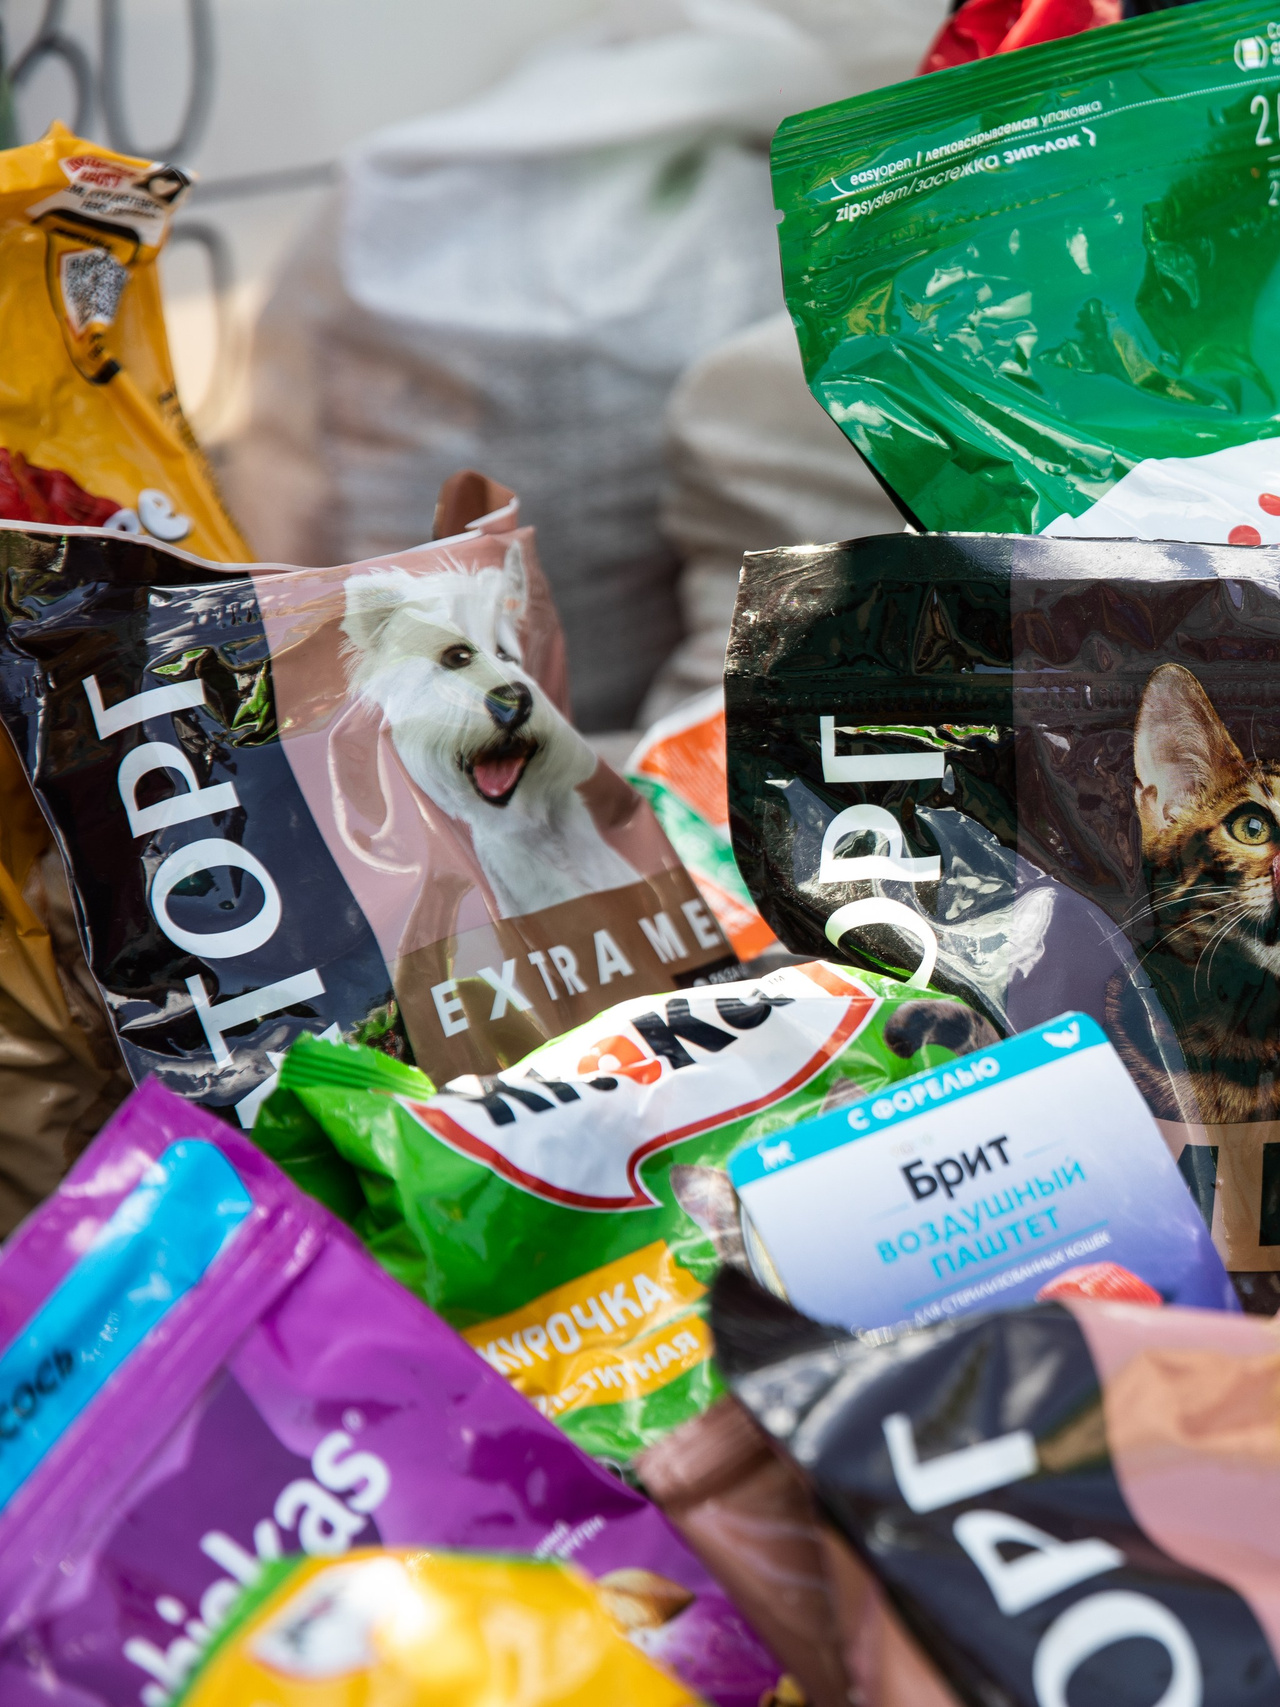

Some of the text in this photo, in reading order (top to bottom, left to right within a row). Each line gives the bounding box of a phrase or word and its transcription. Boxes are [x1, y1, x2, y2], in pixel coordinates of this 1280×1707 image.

[850, 99, 1103, 186] easyopen легковскрываемая упаковка
[1003, 133, 1082, 164] зип-лок
[1250, 94, 1274, 147] 2
[430, 928, 635, 1039] EXTRA
[847, 1056, 1001, 1132] С ФОРЕЛЬЮ
[900, 1133, 1012, 1202] Брит
[874, 1154, 1088, 1266] ВОЗДУШНЫЙ
[929, 1205, 1062, 1282] ПАШТЕТ
[938, 1250, 1066, 1316] СТЕРИЛИЗОВАННЫХ
[1061, 1228, 1114, 1269] КОШЕК
[474, 1272, 672, 1376] КУРОЧКА
